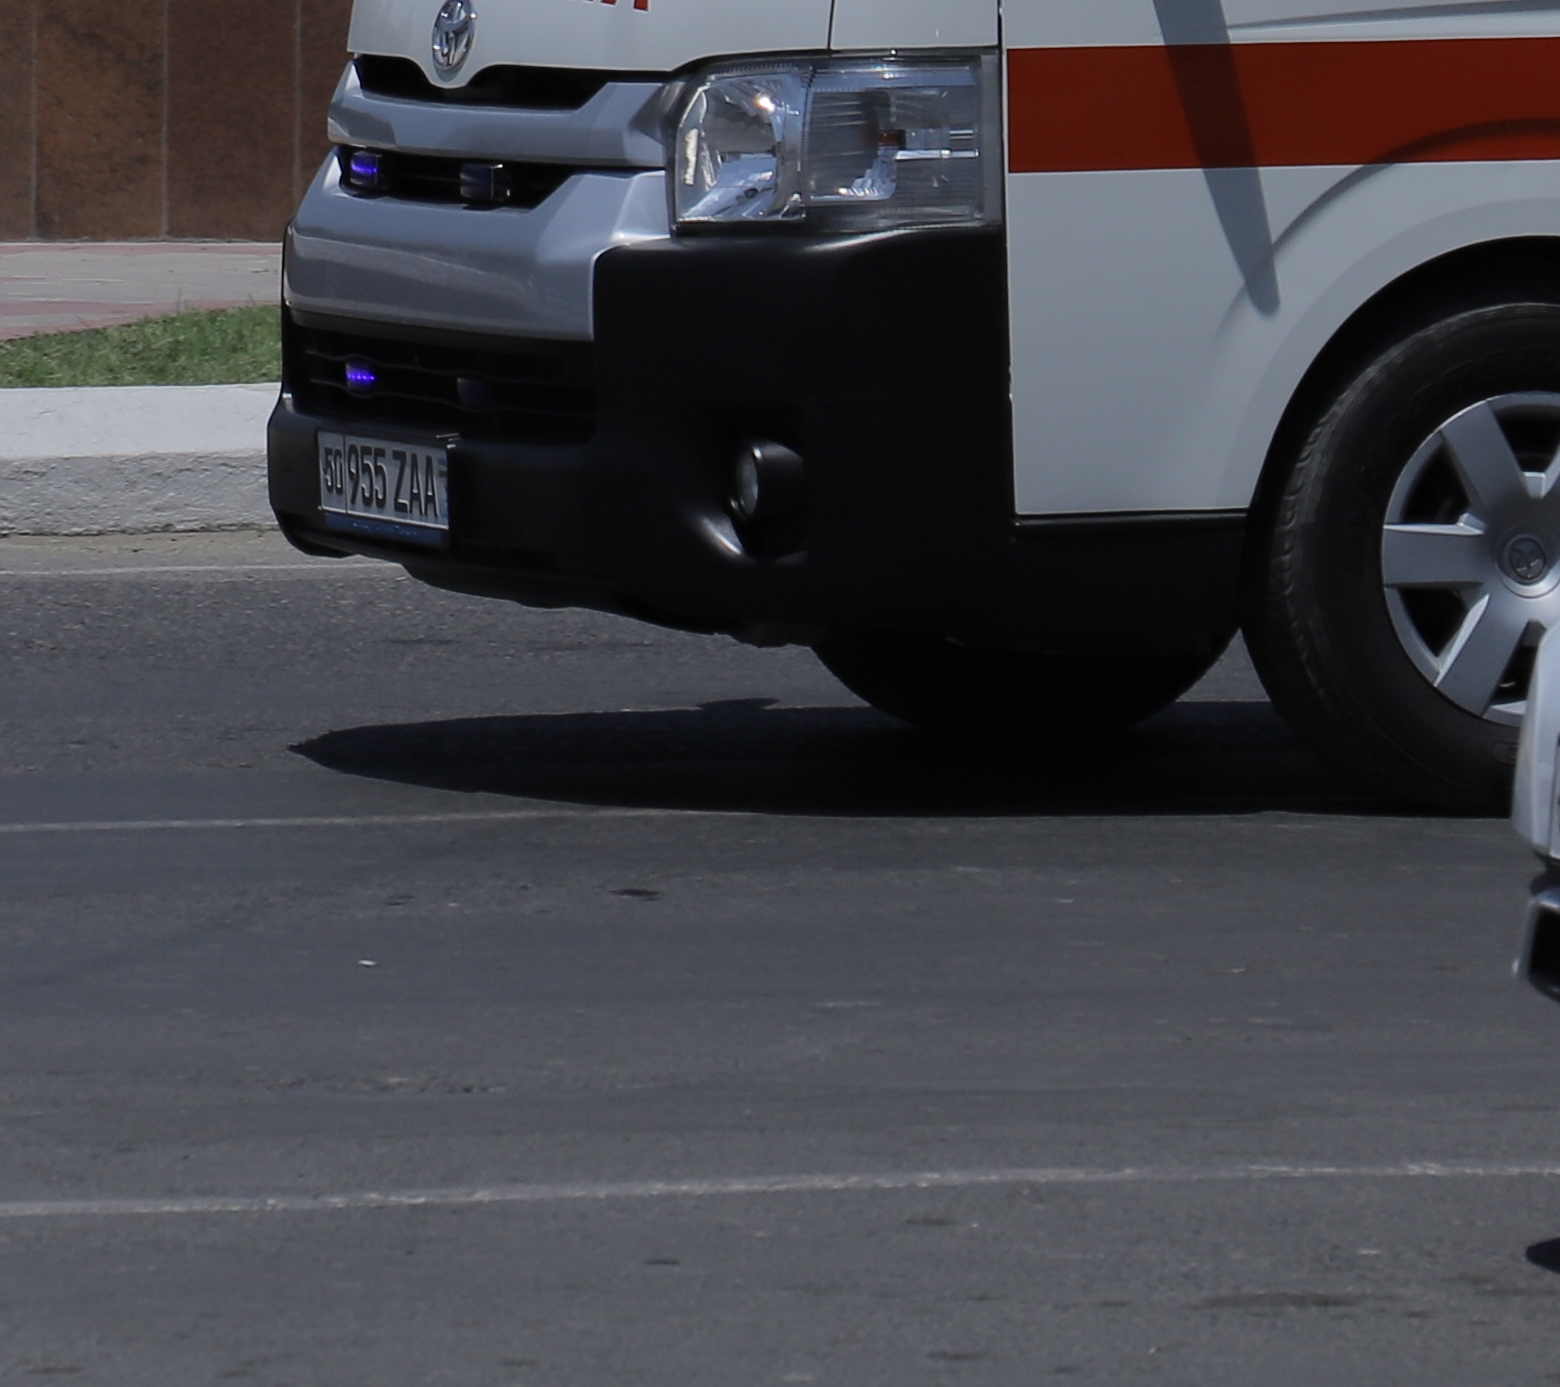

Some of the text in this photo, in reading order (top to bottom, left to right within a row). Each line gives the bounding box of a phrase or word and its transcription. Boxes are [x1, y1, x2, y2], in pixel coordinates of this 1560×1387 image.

[323, 443, 440, 518] 50 955 ZAA
